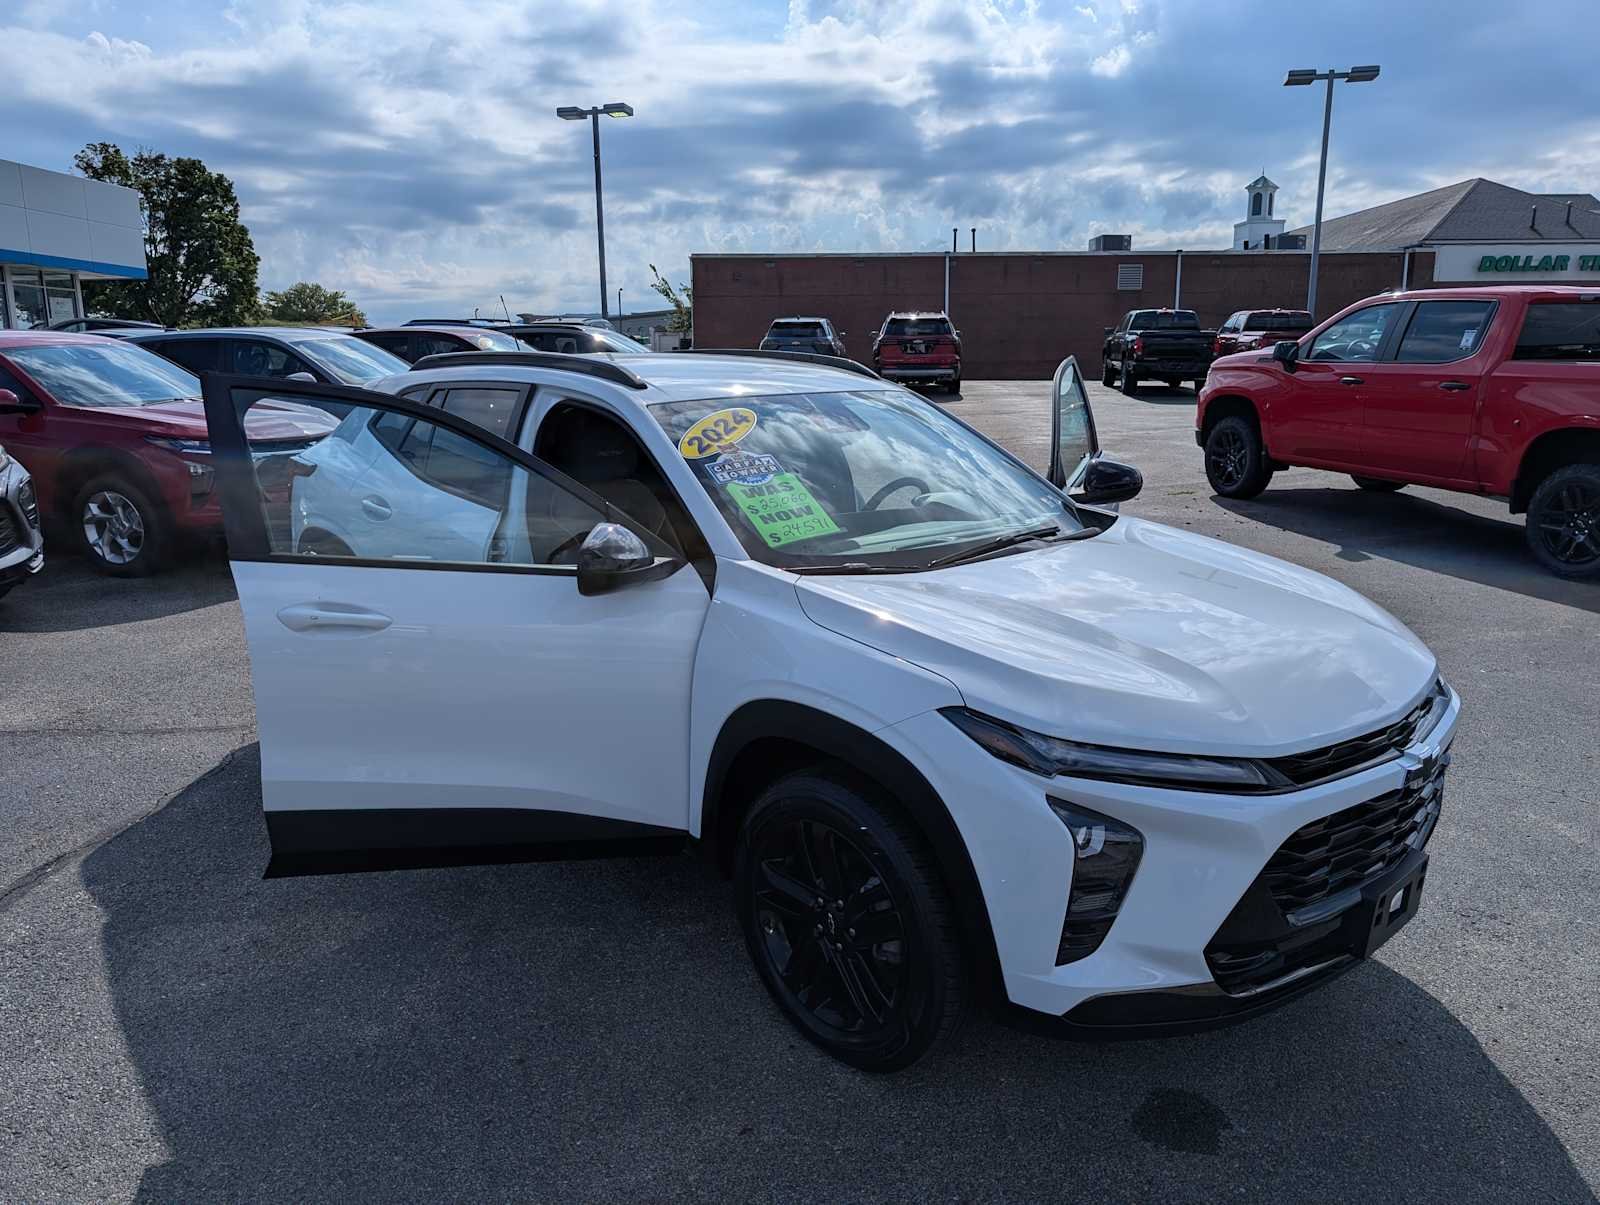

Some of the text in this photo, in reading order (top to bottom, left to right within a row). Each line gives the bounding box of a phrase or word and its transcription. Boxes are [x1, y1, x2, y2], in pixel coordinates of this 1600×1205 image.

[1478, 255, 1570, 272] DOLLAR
[687, 410, 751, 455] 2024
[713, 457, 775, 472] CARFAX
[730, 465, 778, 478] OWNER
[741, 481, 795, 498] WAS
[758, 505, 815, 525] NOW
